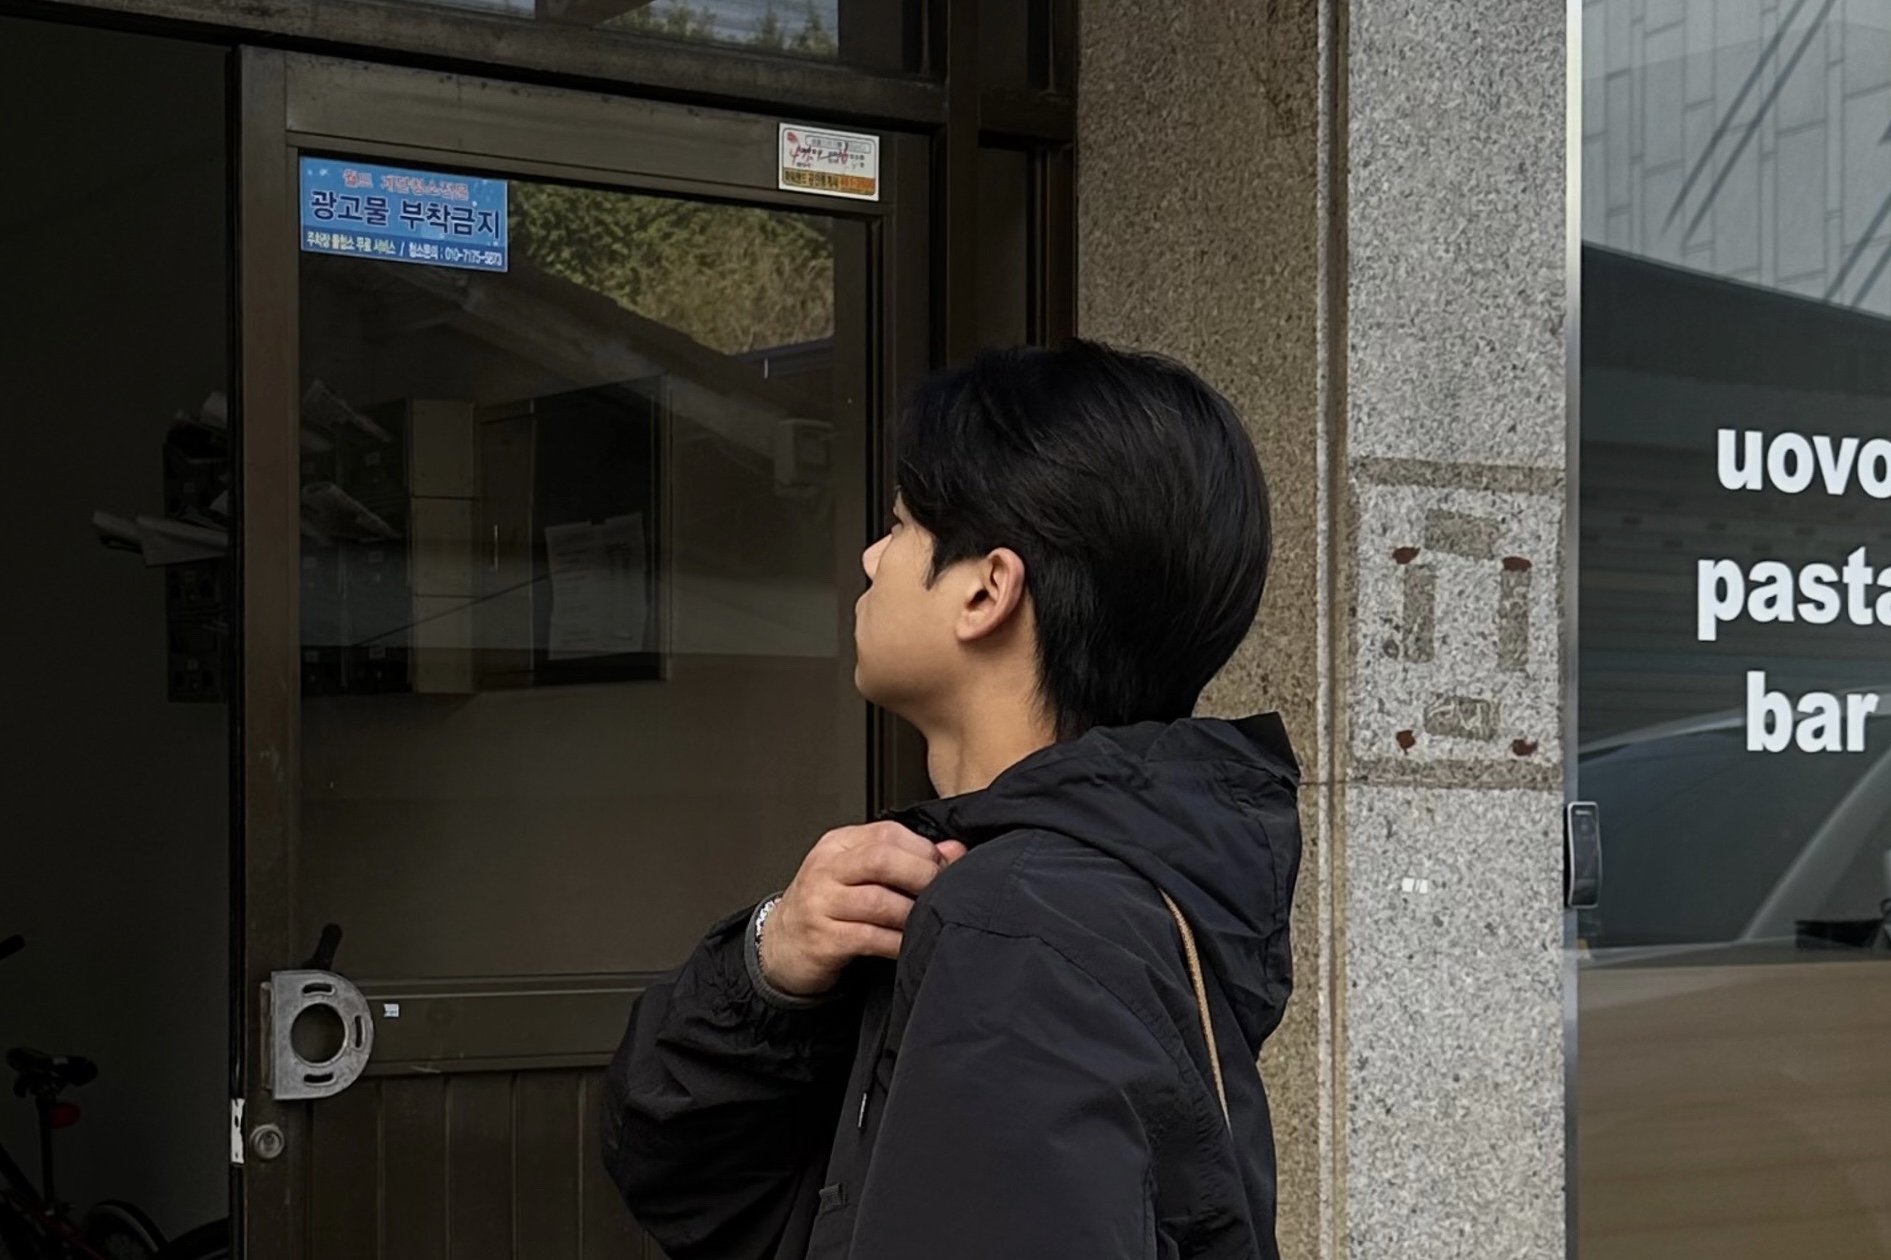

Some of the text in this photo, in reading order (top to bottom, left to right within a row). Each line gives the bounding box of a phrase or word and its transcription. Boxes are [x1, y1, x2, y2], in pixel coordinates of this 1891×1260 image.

[311, 189, 502, 240] 광고물 부착금지
[1717, 428, 1891, 499] uovo
[1746, 670, 1880, 753] bar
